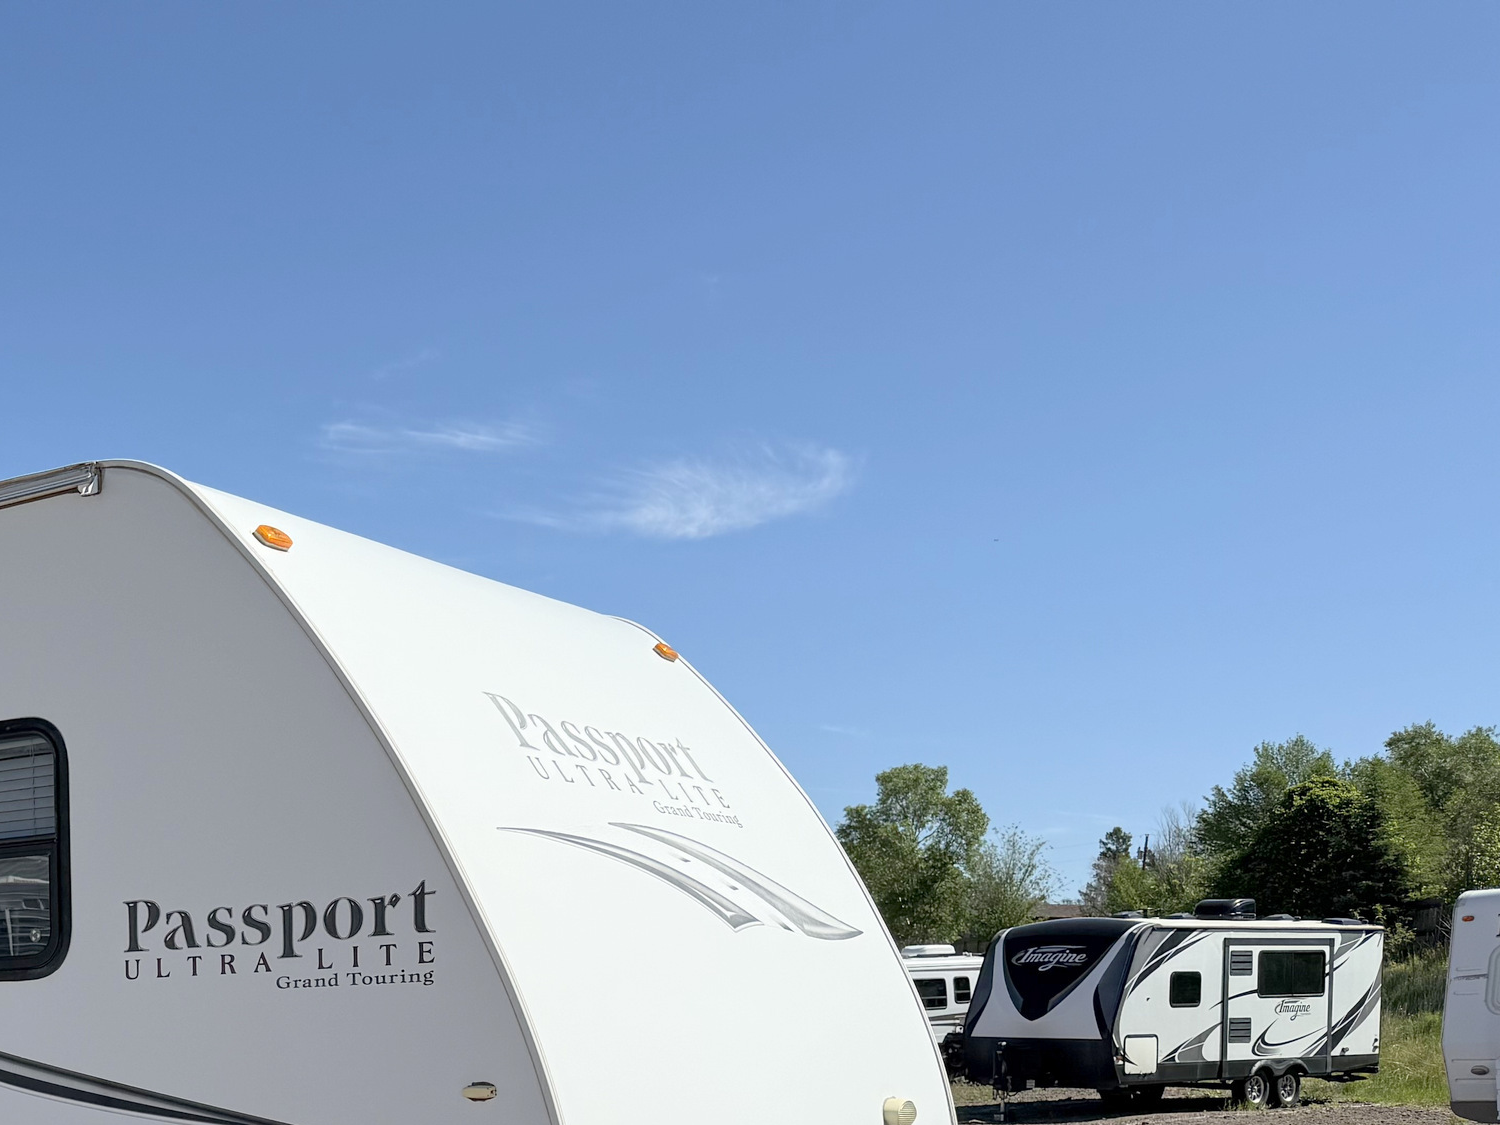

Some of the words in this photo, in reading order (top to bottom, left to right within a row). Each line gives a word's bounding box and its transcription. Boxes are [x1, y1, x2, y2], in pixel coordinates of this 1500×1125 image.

[482, 691, 714, 785] Passport
[526, 755, 644, 795] ULTRA
[658, 779, 730, 809] LITE
[652, 800, 694, 819] Grand
[694, 806, 743, 829] Touring
[122, 879, 437, 960] Passport
[124, 952, 273, 981] ULTRA
[317, 941, 436, 970] LITE
[1016, 947, 1088, 971] Imagine
[276, 972, 339, 990] Grand
[349, 969, 435, 986] Touring
[1278, 999, 1311, 1021] Imagine
